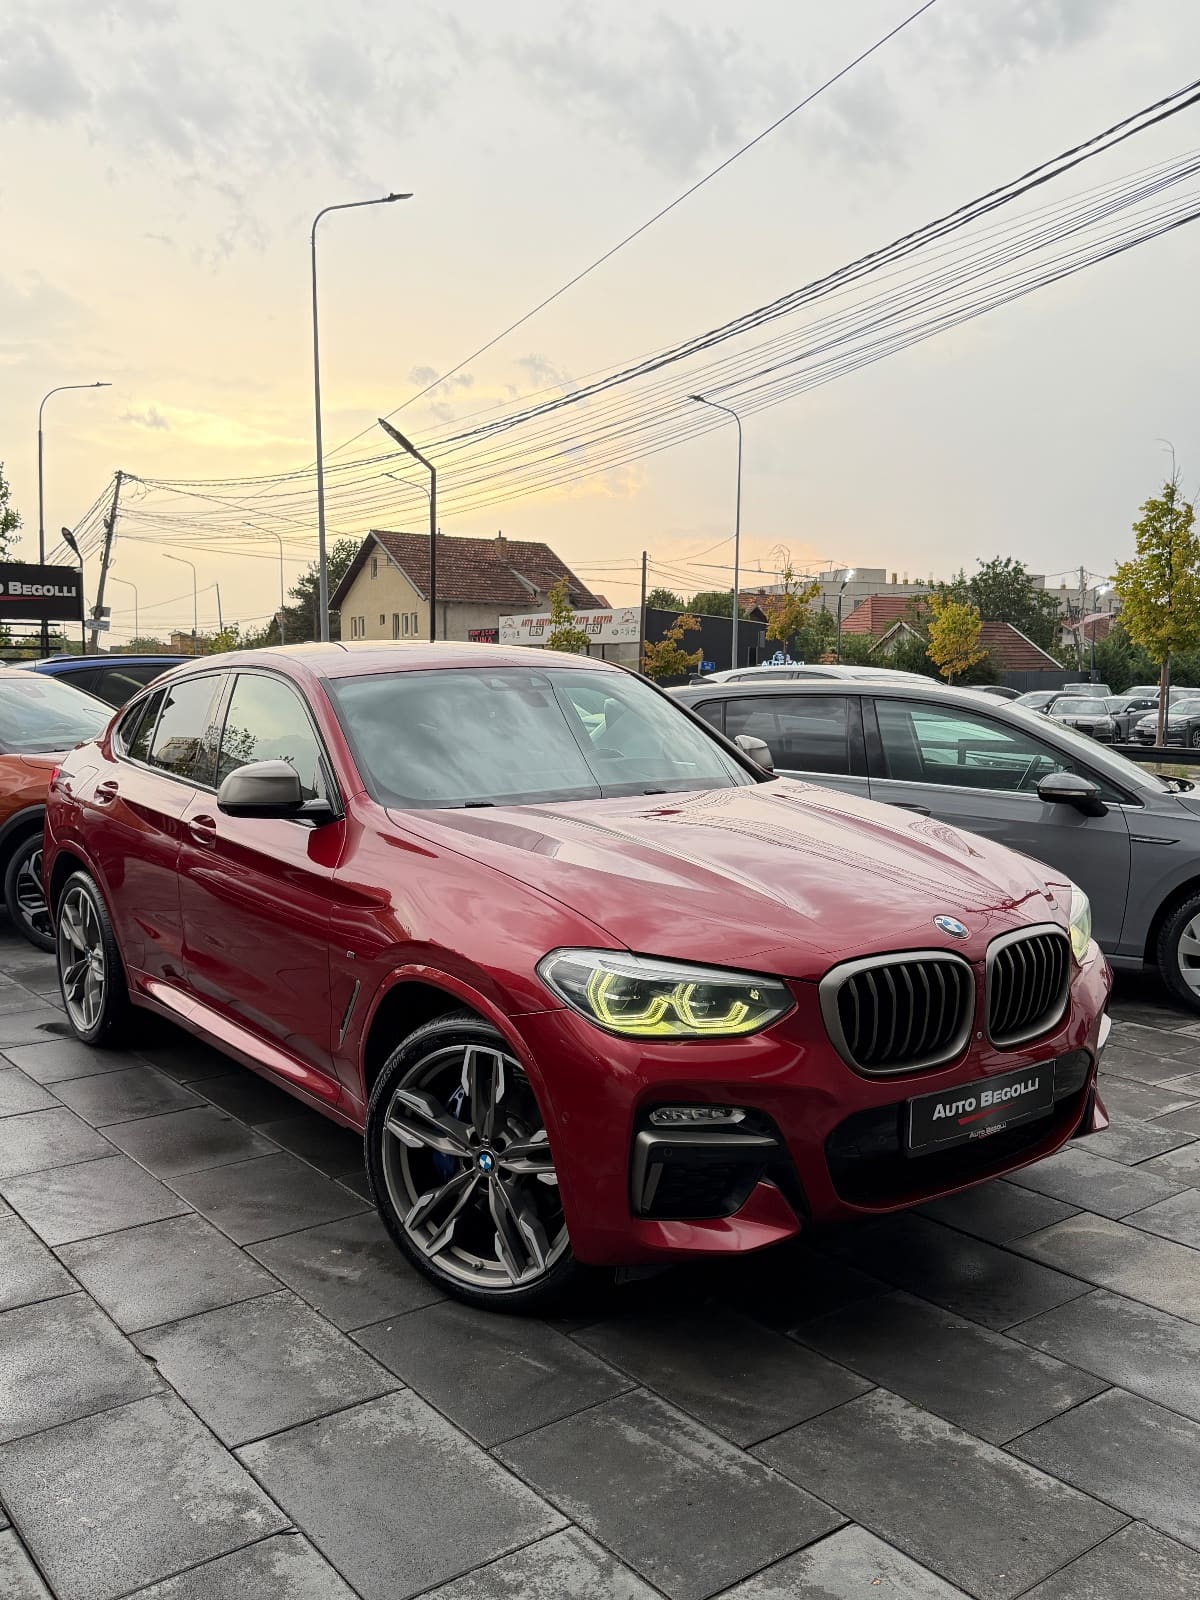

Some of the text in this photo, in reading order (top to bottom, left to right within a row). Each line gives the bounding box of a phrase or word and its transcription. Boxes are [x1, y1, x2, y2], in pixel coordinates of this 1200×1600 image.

[8, 581, 76, 597] BEGOLLI
[932, 1077, 1039, 1121] AUTO BEGOLLI
